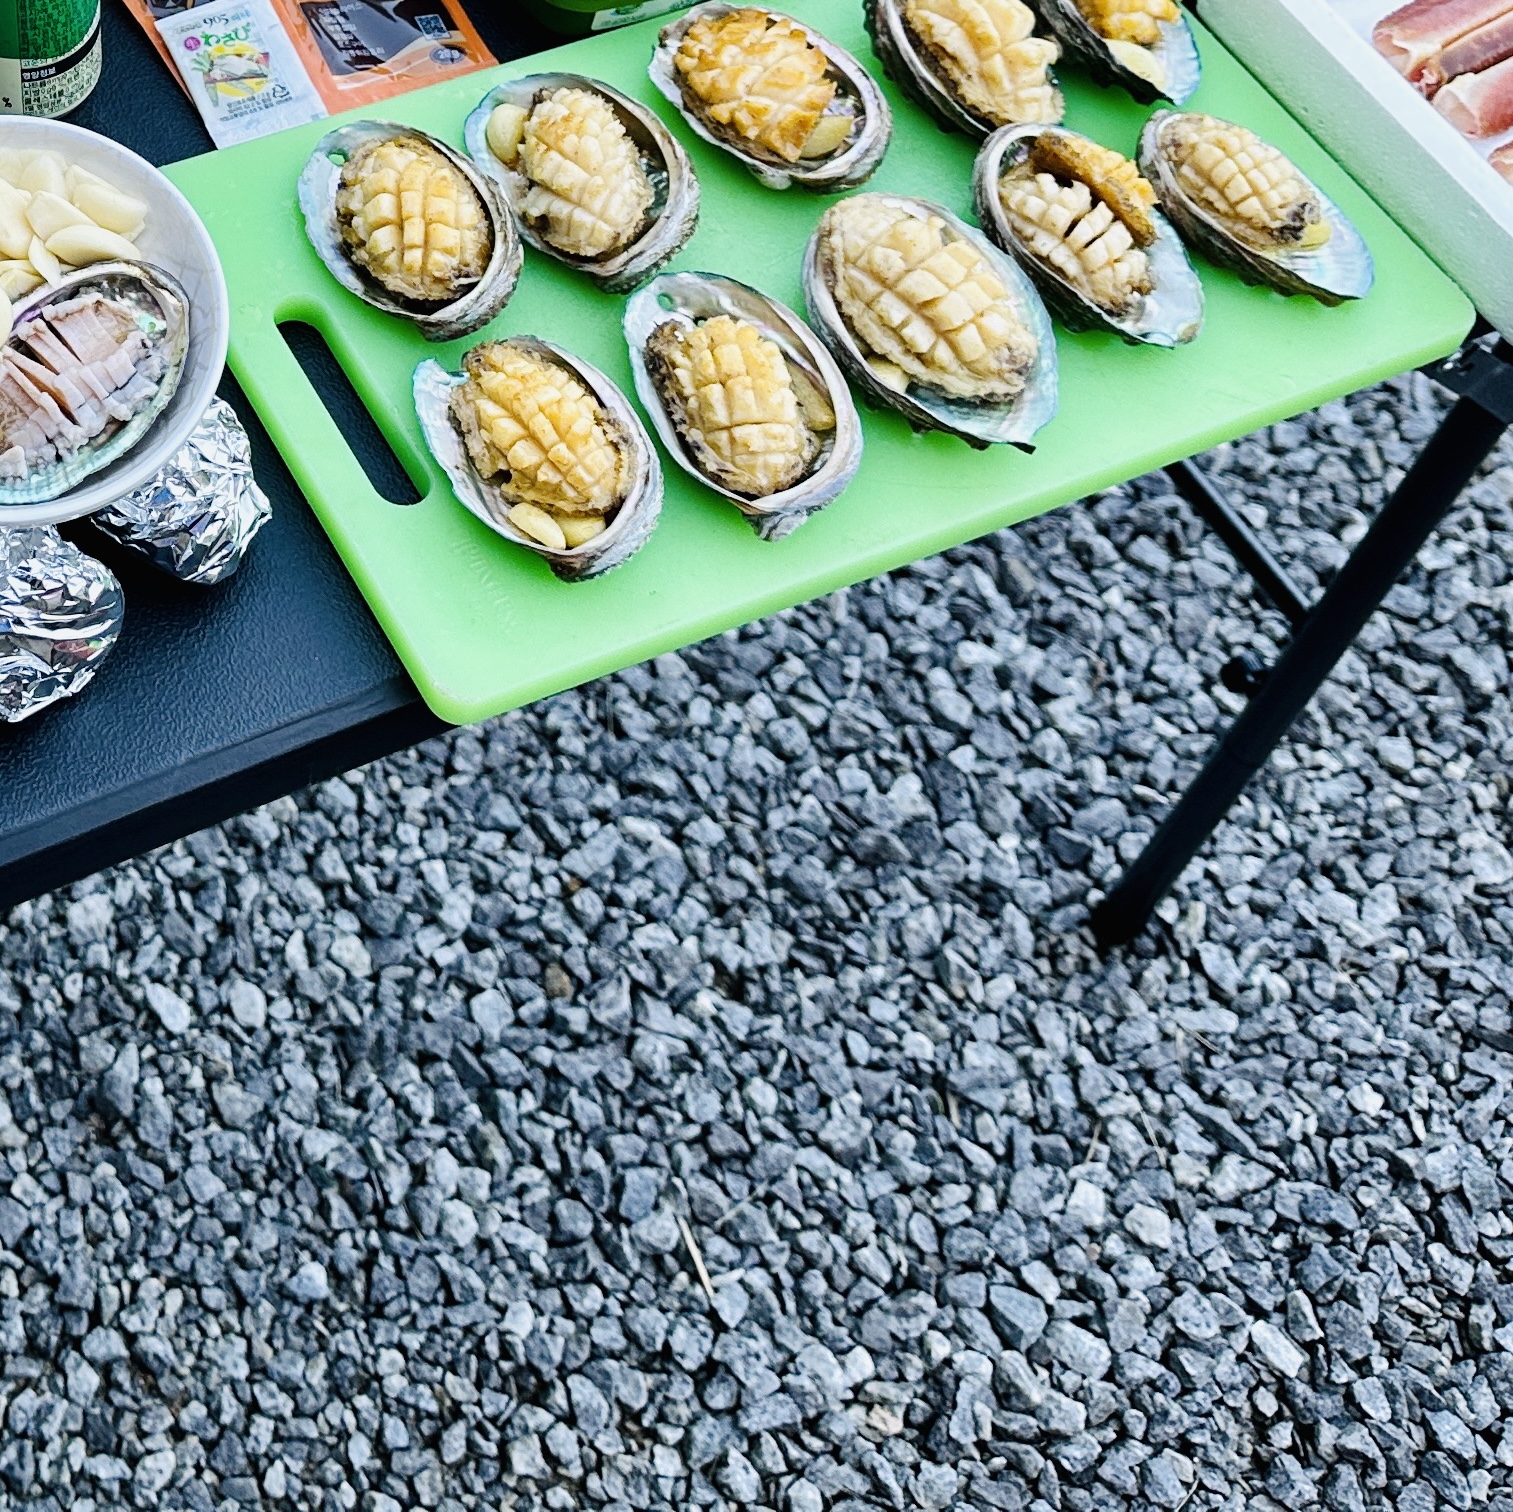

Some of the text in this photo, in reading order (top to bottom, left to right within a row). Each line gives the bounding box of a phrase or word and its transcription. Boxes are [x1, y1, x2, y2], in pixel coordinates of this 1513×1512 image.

[200, 22, 252, 48] わさび
[1, 96, 13, 108] %
